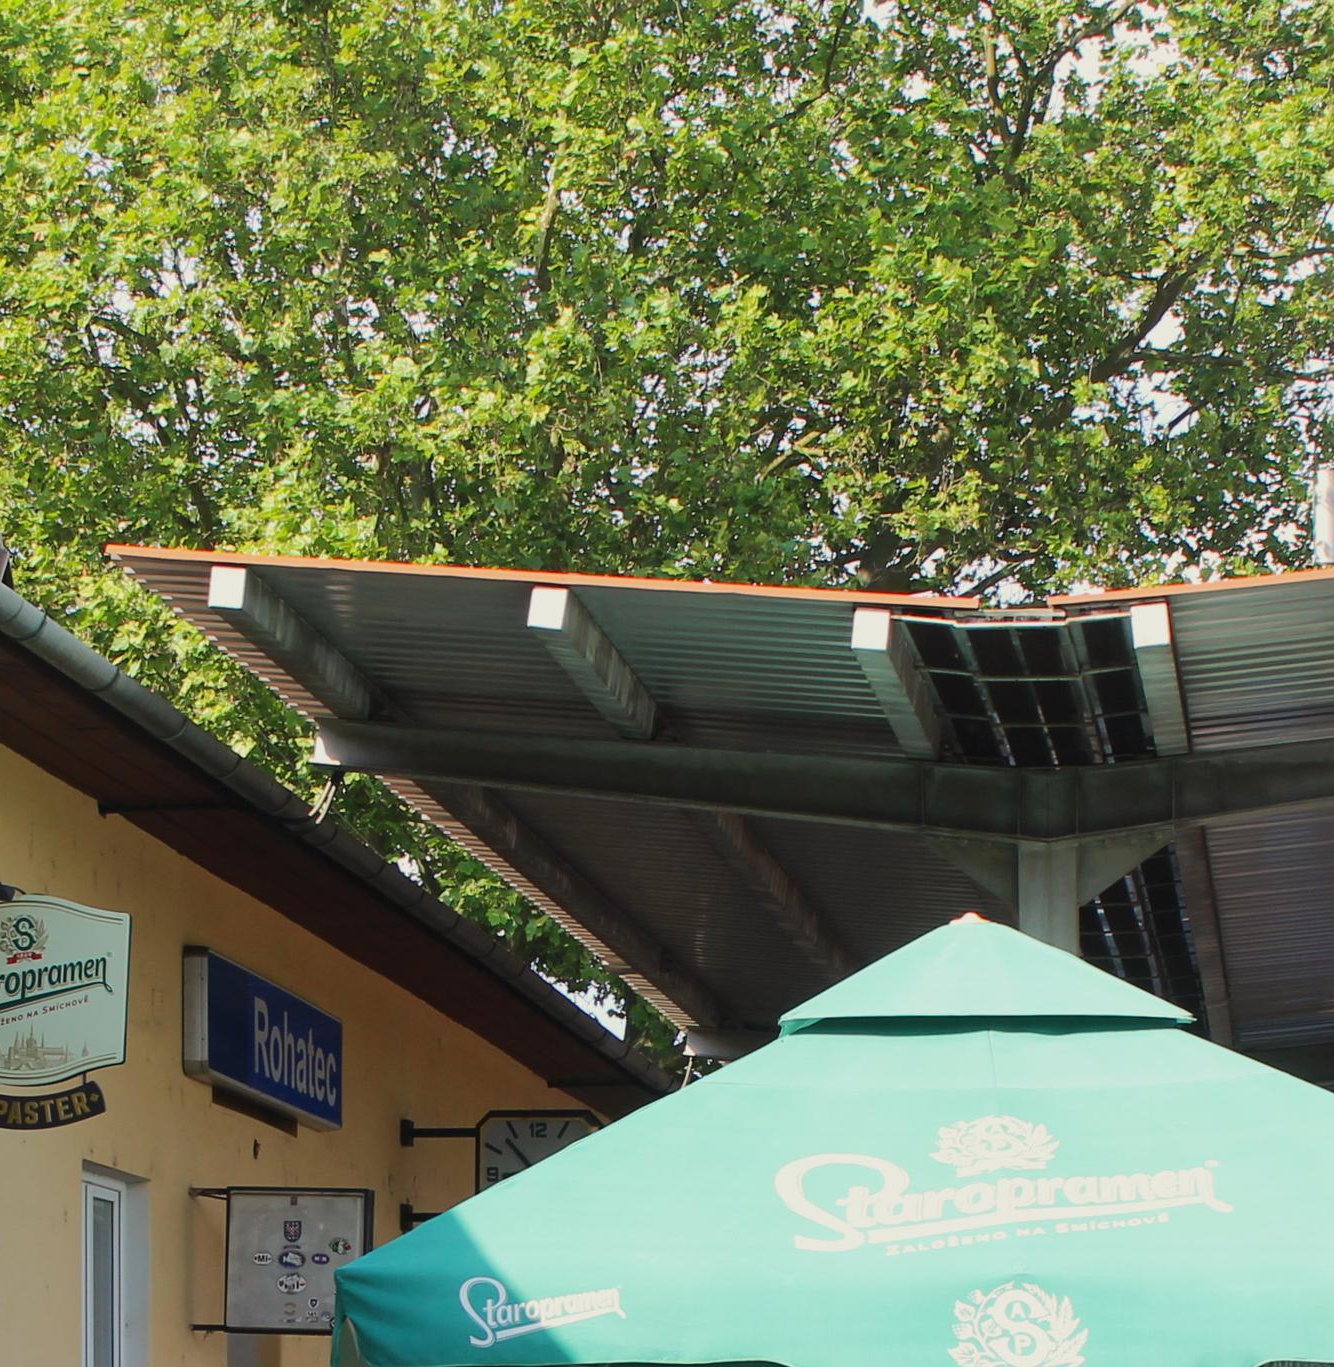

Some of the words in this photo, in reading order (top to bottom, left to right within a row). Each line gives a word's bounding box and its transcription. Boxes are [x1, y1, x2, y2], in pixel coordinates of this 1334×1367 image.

[26, 1008, 39, 1018] NA
[253, 996, 336, 1107] Rohatec
[529, 1121, 547, 1138] 12
[486, 1166, 501, 1183] 9
[774, 1152, 1234, 1253] Staropramen
[459, 1276, 627, 1348] Staropramen
